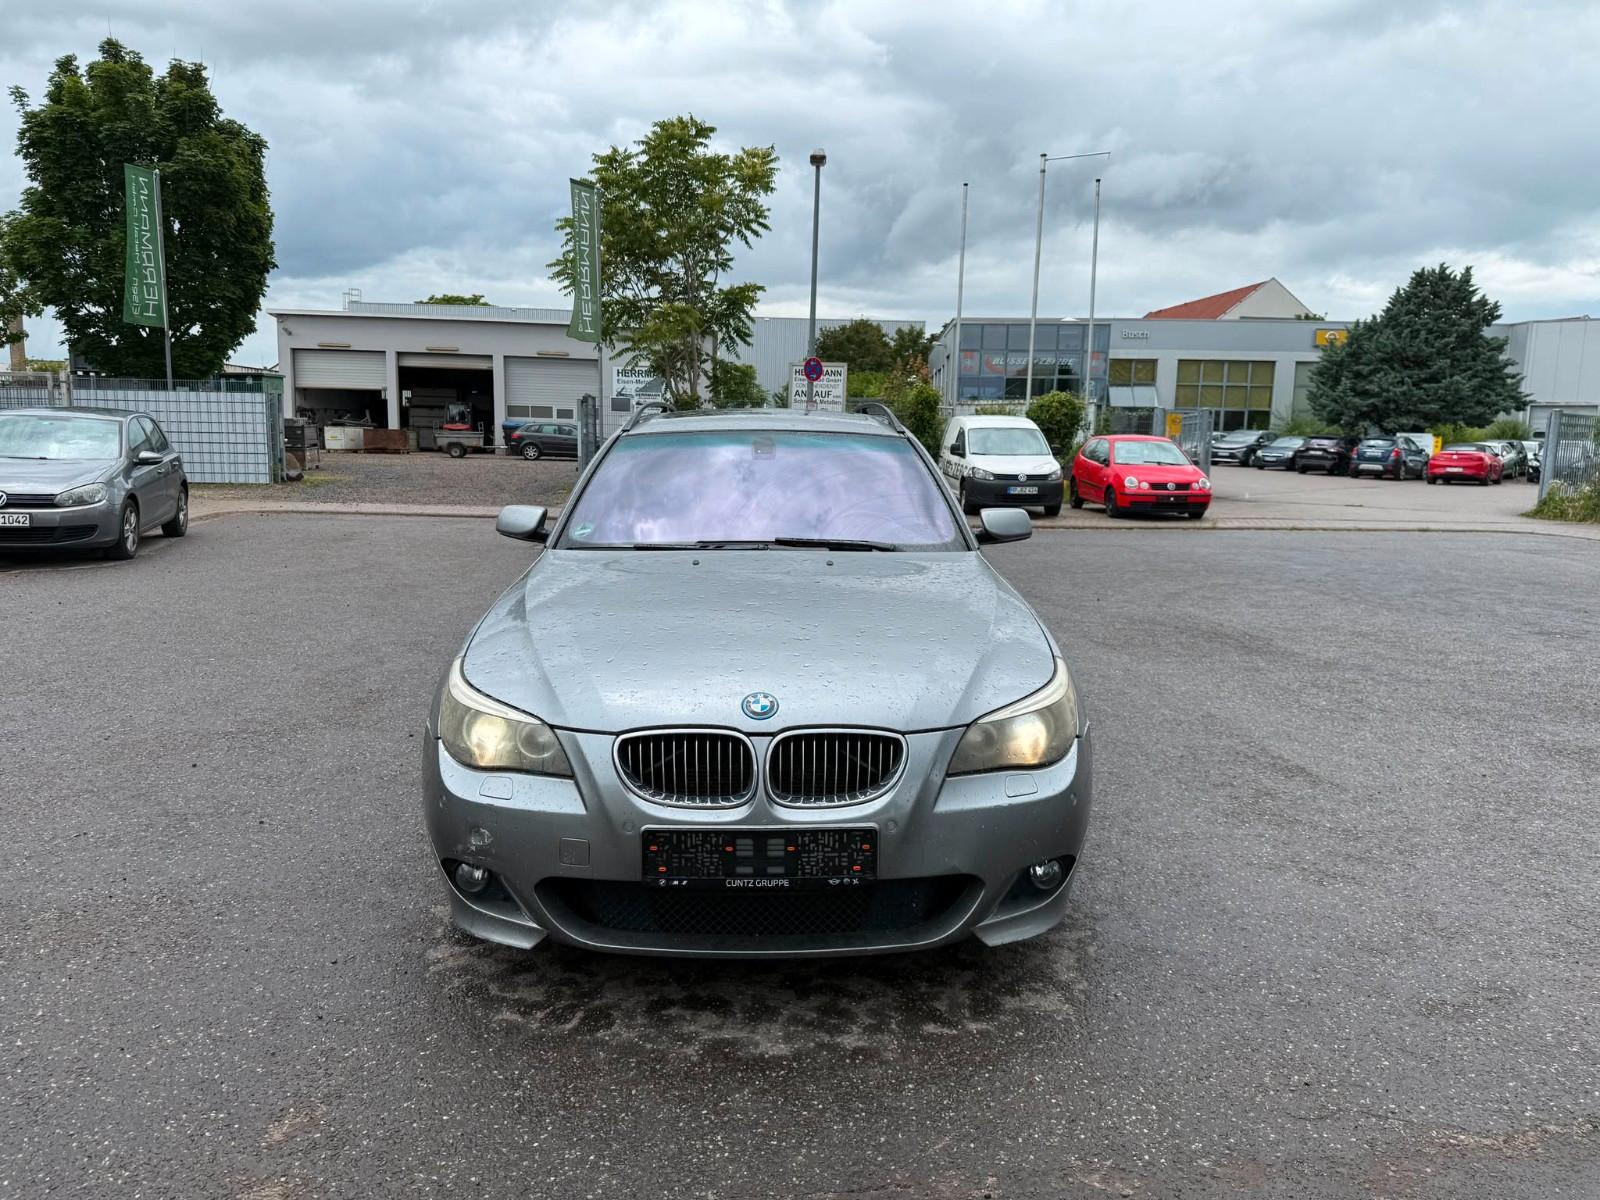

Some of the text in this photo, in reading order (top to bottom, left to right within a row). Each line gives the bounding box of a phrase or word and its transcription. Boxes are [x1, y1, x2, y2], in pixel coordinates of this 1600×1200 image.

[1122, 328, 1149, 338] Busch
[795, 368, 842, 377] HEANN
[794, 389, 833, 398] ANAUF
[1, 515, 28, 525] 1042
[726, 879, 790, 887] CUNTZ GRUPPE
